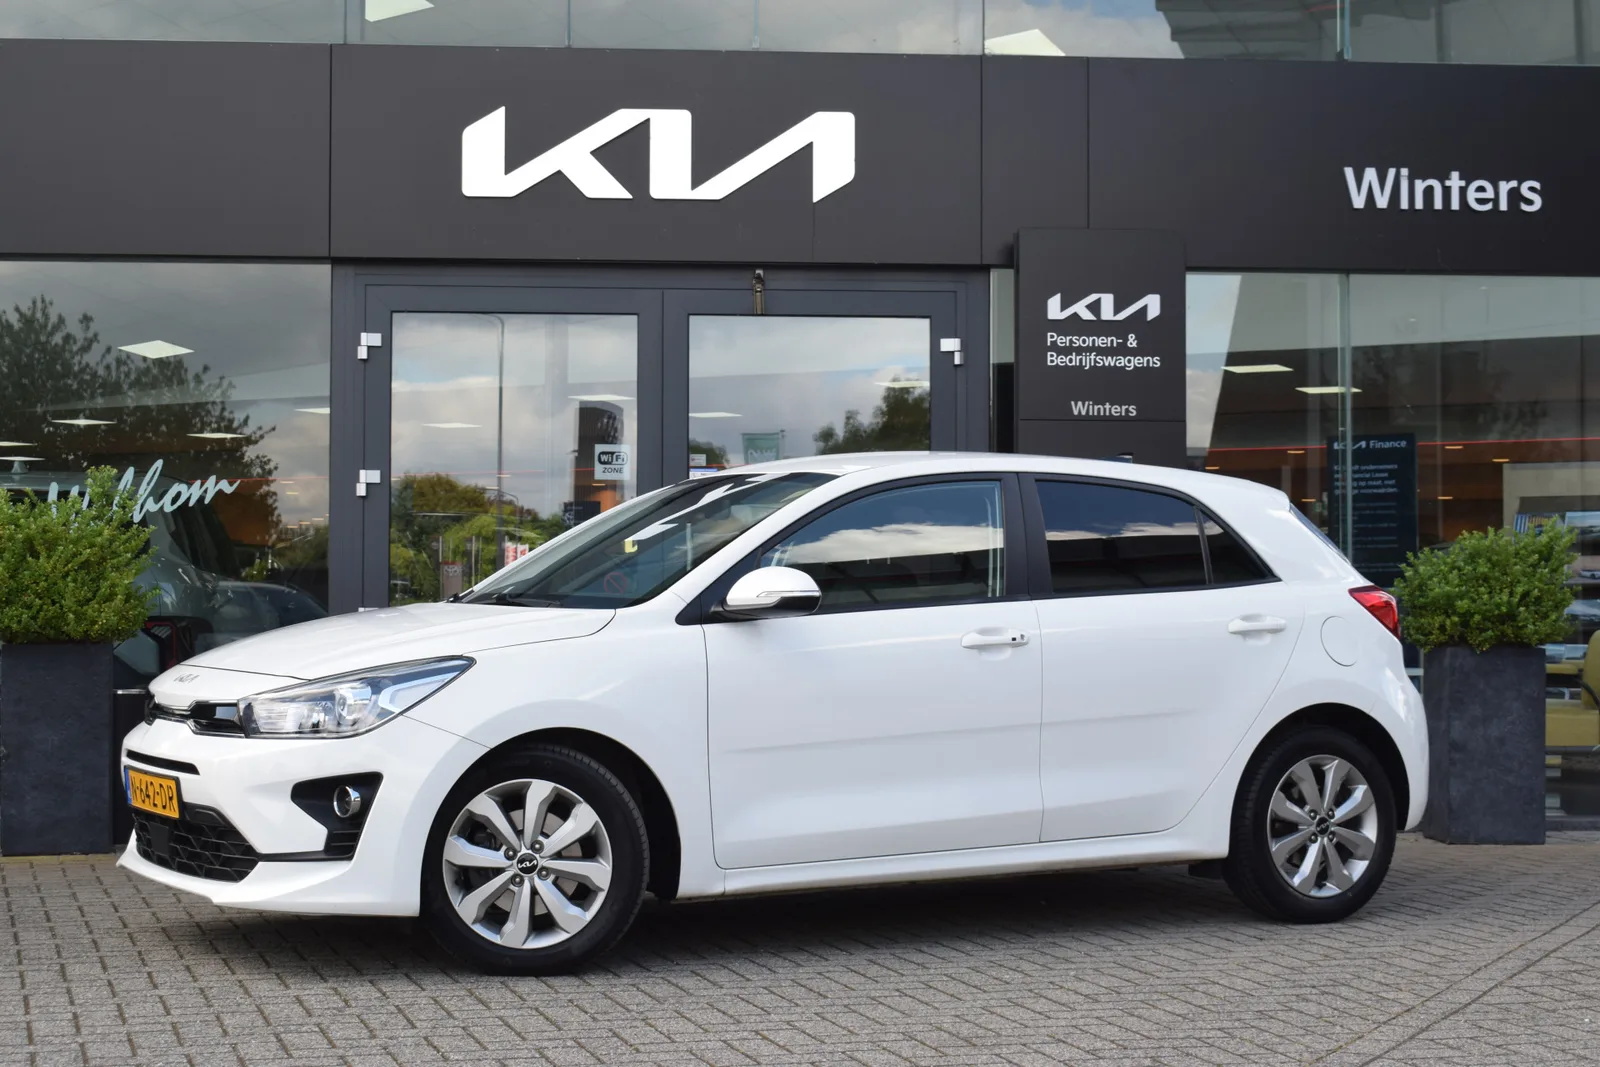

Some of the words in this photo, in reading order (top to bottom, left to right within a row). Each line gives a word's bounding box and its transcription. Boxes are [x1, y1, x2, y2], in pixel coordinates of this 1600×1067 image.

[462, 106, 855, 203] KIA
[1344, 166, 1542, 213] Winters
[1047, 293, 1161, 322] KIA
[1047, 332, 1123, 347] Personen-
[1127, 333, 1138, 348] &
[1047, 352, 1161, 370] Bedrijfswagens
[1071, 401, 1137, 417] Winters
[1333, 440, 1366, 450] KA
[1369, 440, 1407, 449] Finance
[131, 775, 177, 812] N-642-DR
